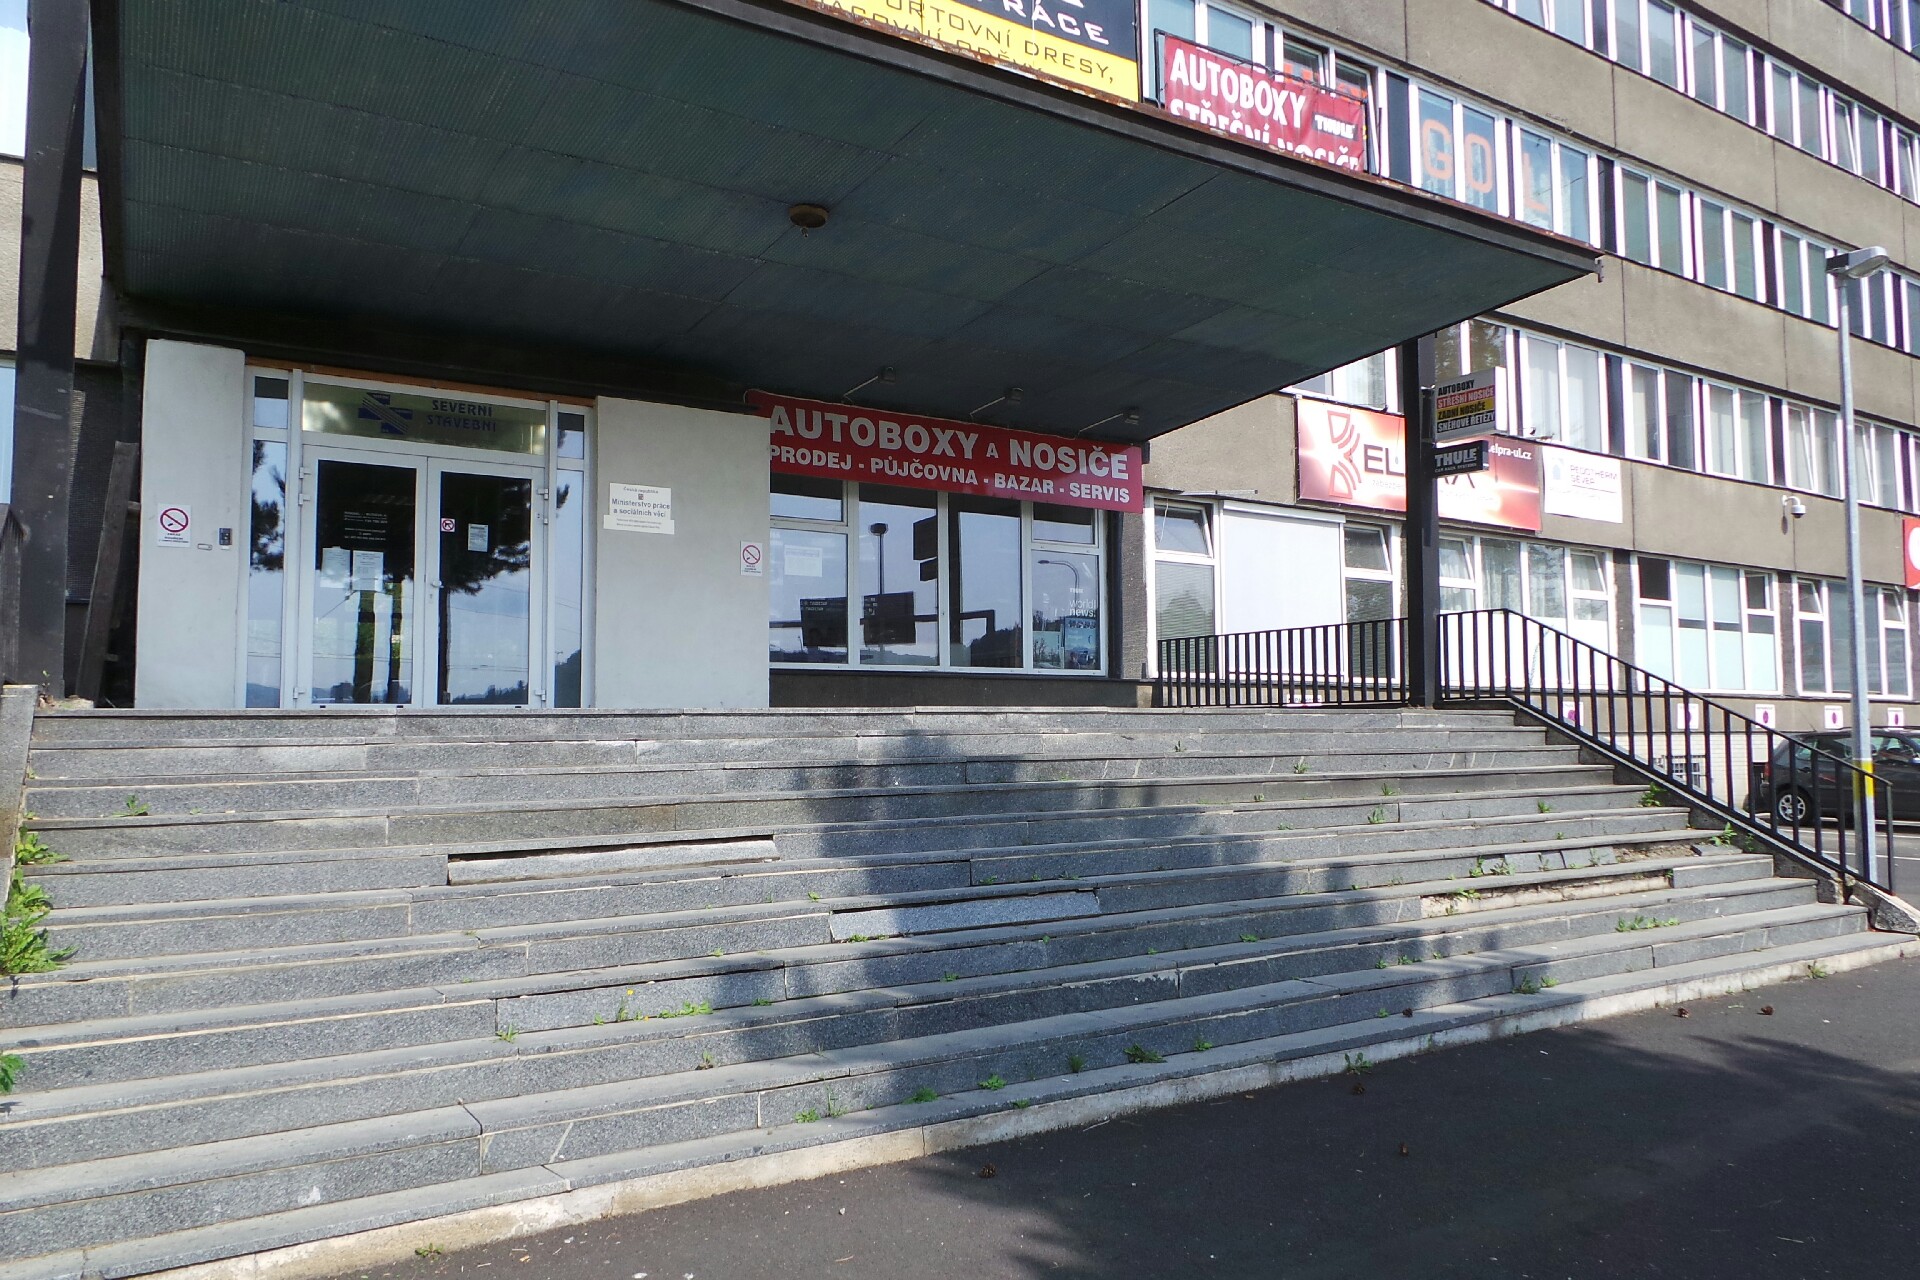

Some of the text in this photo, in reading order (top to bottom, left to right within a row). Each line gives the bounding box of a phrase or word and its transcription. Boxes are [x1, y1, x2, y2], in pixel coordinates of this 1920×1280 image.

[1170, 48, 1307, 128] AUTOBOXY
[1315, 115, 1355, 139] THULE
[1437, 379, 1475, 397] AUTOBOXY
[769, 405, 979, 459] AUTOBOXY
[1009, 438, 1129, 480] NOSIČE
[1434, 447, 1478, 467] THULE
[769, 444, 1130, 504] PRODEJ PŮJČOVNA BAZAR SERVIS
[611, 498, 652, 508] Ministerstvo
